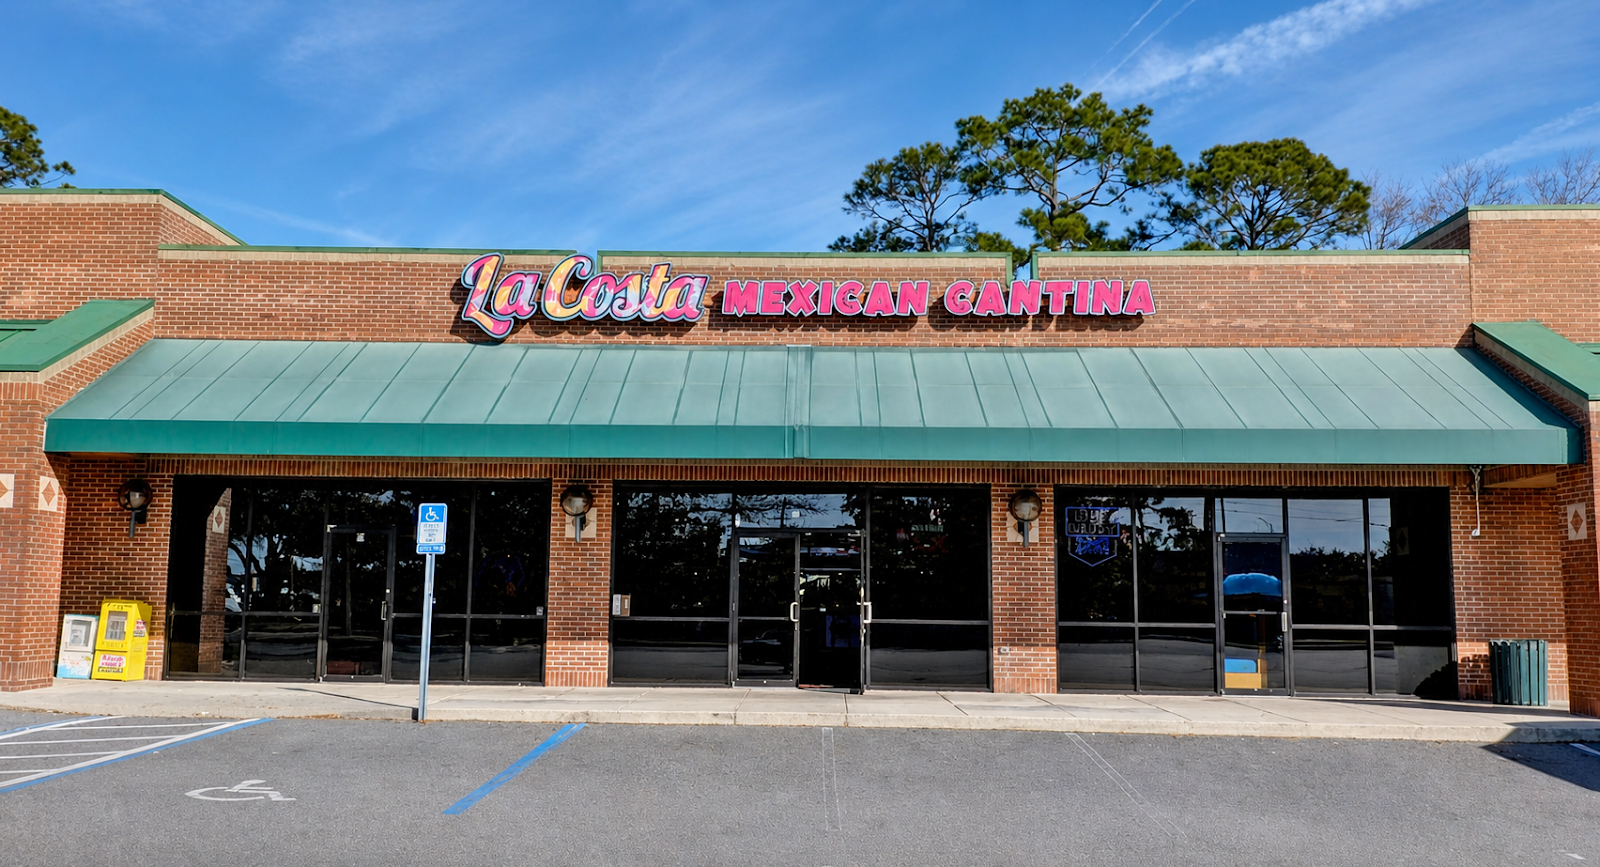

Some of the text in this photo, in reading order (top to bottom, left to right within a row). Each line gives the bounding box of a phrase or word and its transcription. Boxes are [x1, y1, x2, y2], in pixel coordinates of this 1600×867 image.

[461, 252, 1156, 338] La Costa MEXICAN CANTINA
